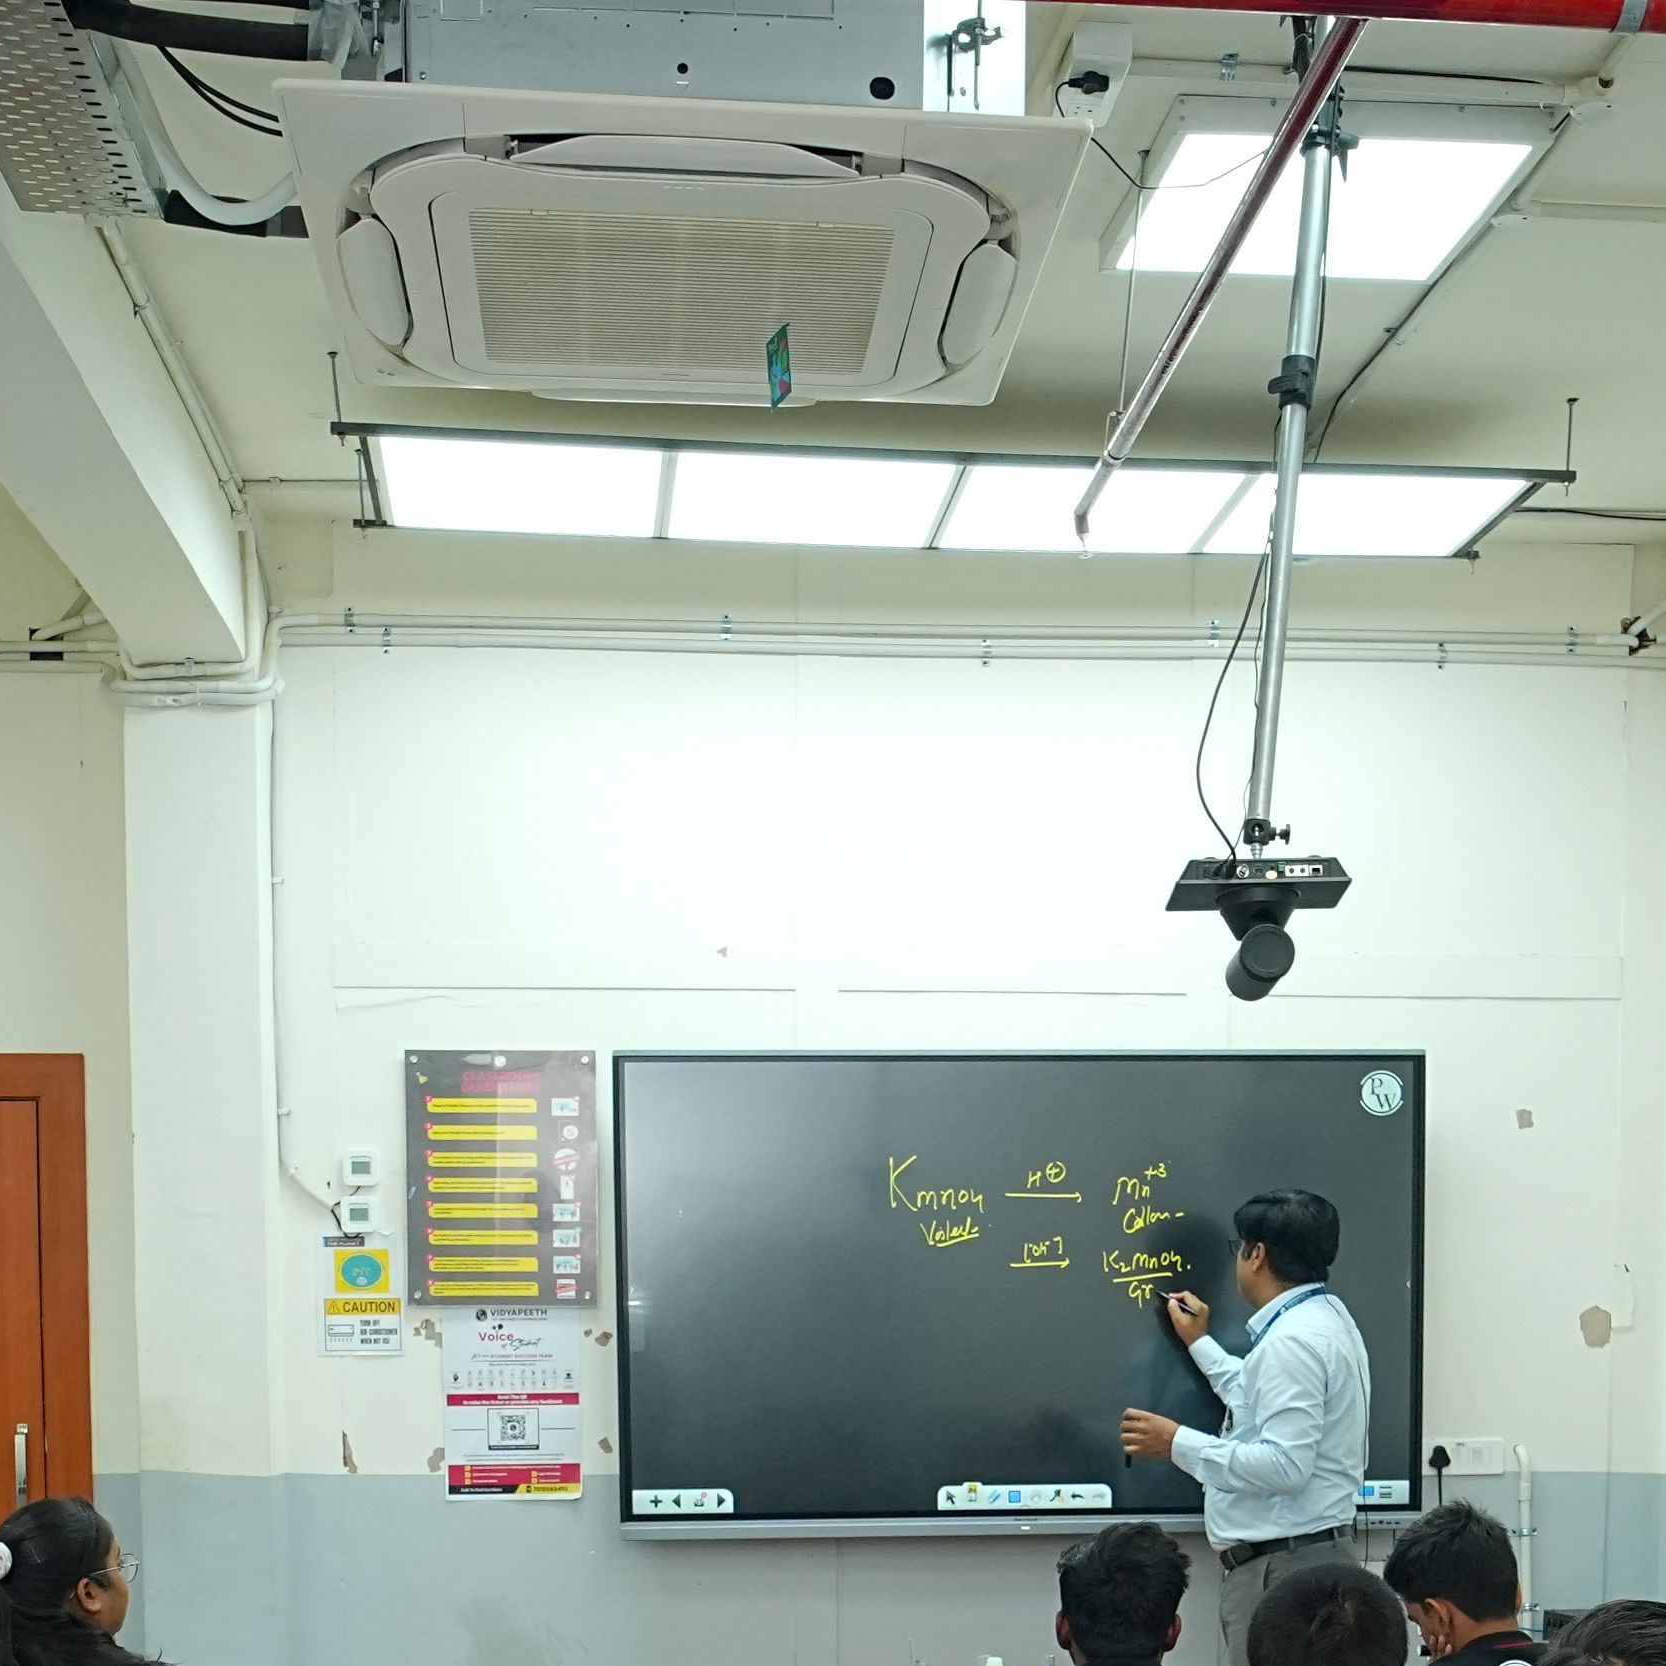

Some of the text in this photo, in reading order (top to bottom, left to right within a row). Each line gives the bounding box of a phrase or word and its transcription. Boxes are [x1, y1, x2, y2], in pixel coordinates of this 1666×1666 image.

[343, 1301, 396, 1314] CAUTION
[490, 1308, 548, 1317] VIDYAPEETH
[478, 1331, 514, 1342] Voice
